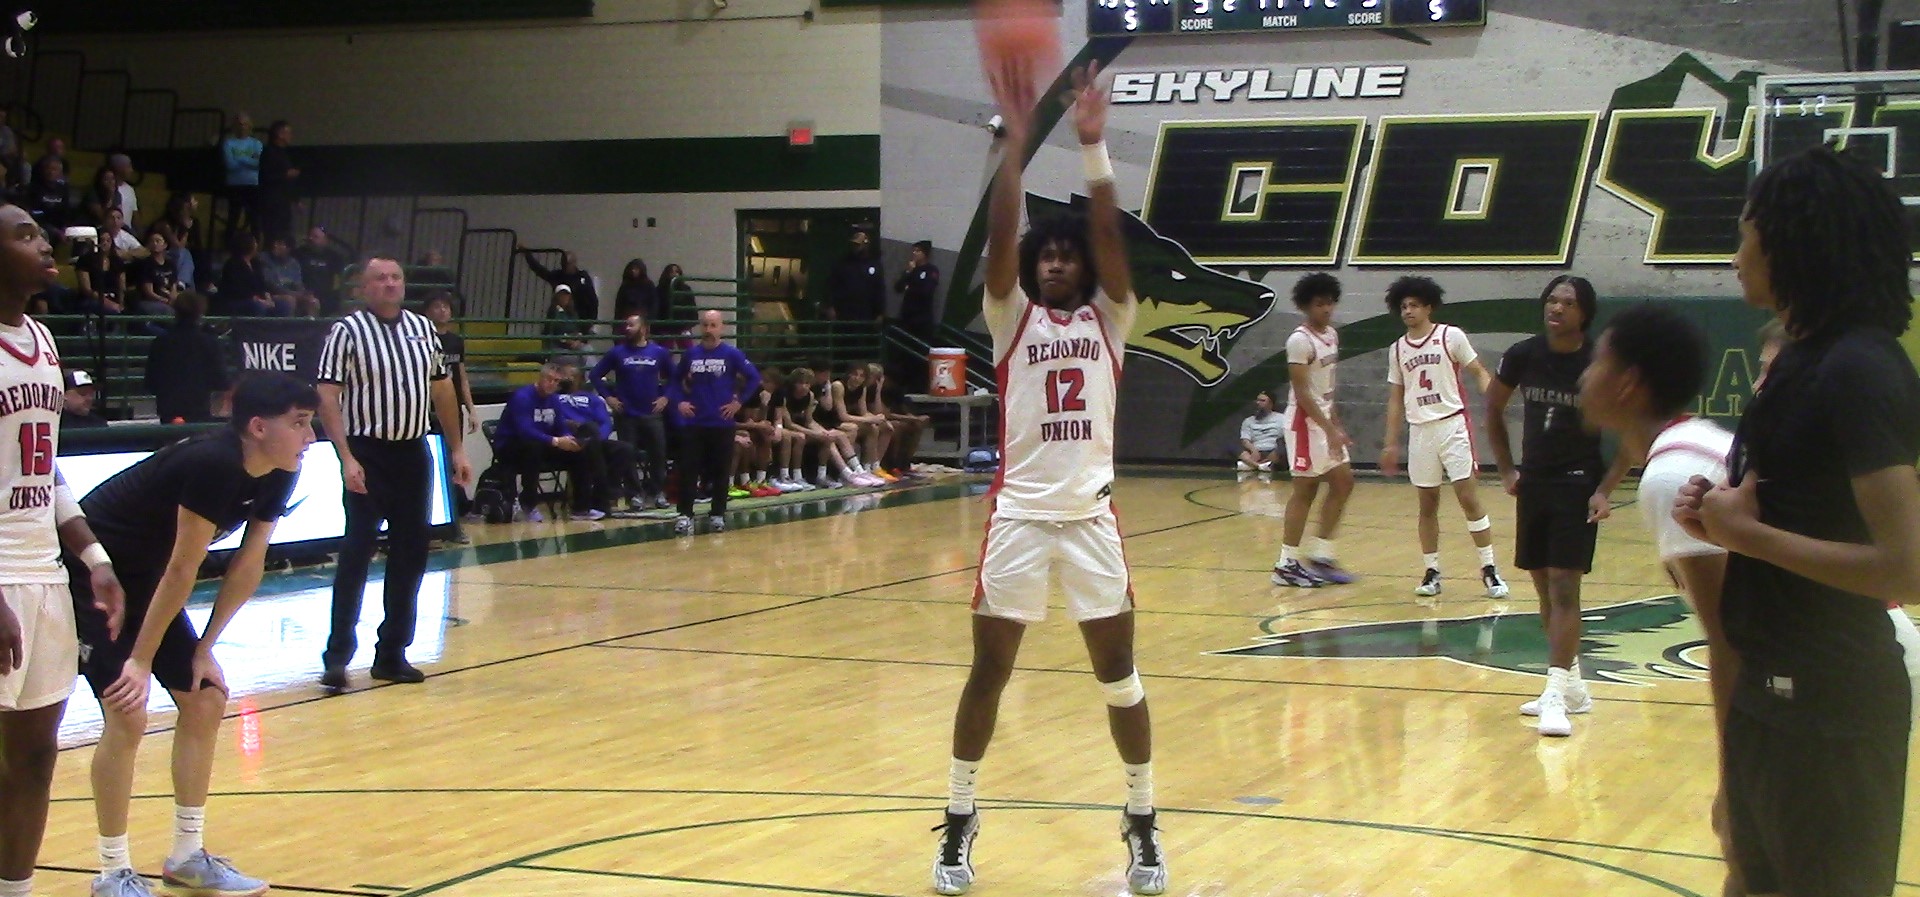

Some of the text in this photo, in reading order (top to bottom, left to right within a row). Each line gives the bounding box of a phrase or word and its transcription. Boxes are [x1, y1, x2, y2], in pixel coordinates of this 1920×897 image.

[1180, 18, 1213, 31] SCORE
[1262, 15, 1297, 27] MATCH
[1348, 12, 1382, 25] SCORE
[1111, 65, 1407, 104] SKYLINE
[1142, 103, 1920, 266] COY
[243, 342, 296, 371] NIKE
[1027, 337, 1101, 366] REDONDO
[1404, 353, 1442, 373] REDONDO
[1045, 368, 1087, 414] 12
[1419, 369, 1433, 391] 4
[1416, 393, 1443, 407] UNION
[1040, 420, 1093, 442] UNION
[18, 422, 53, 476] 15
